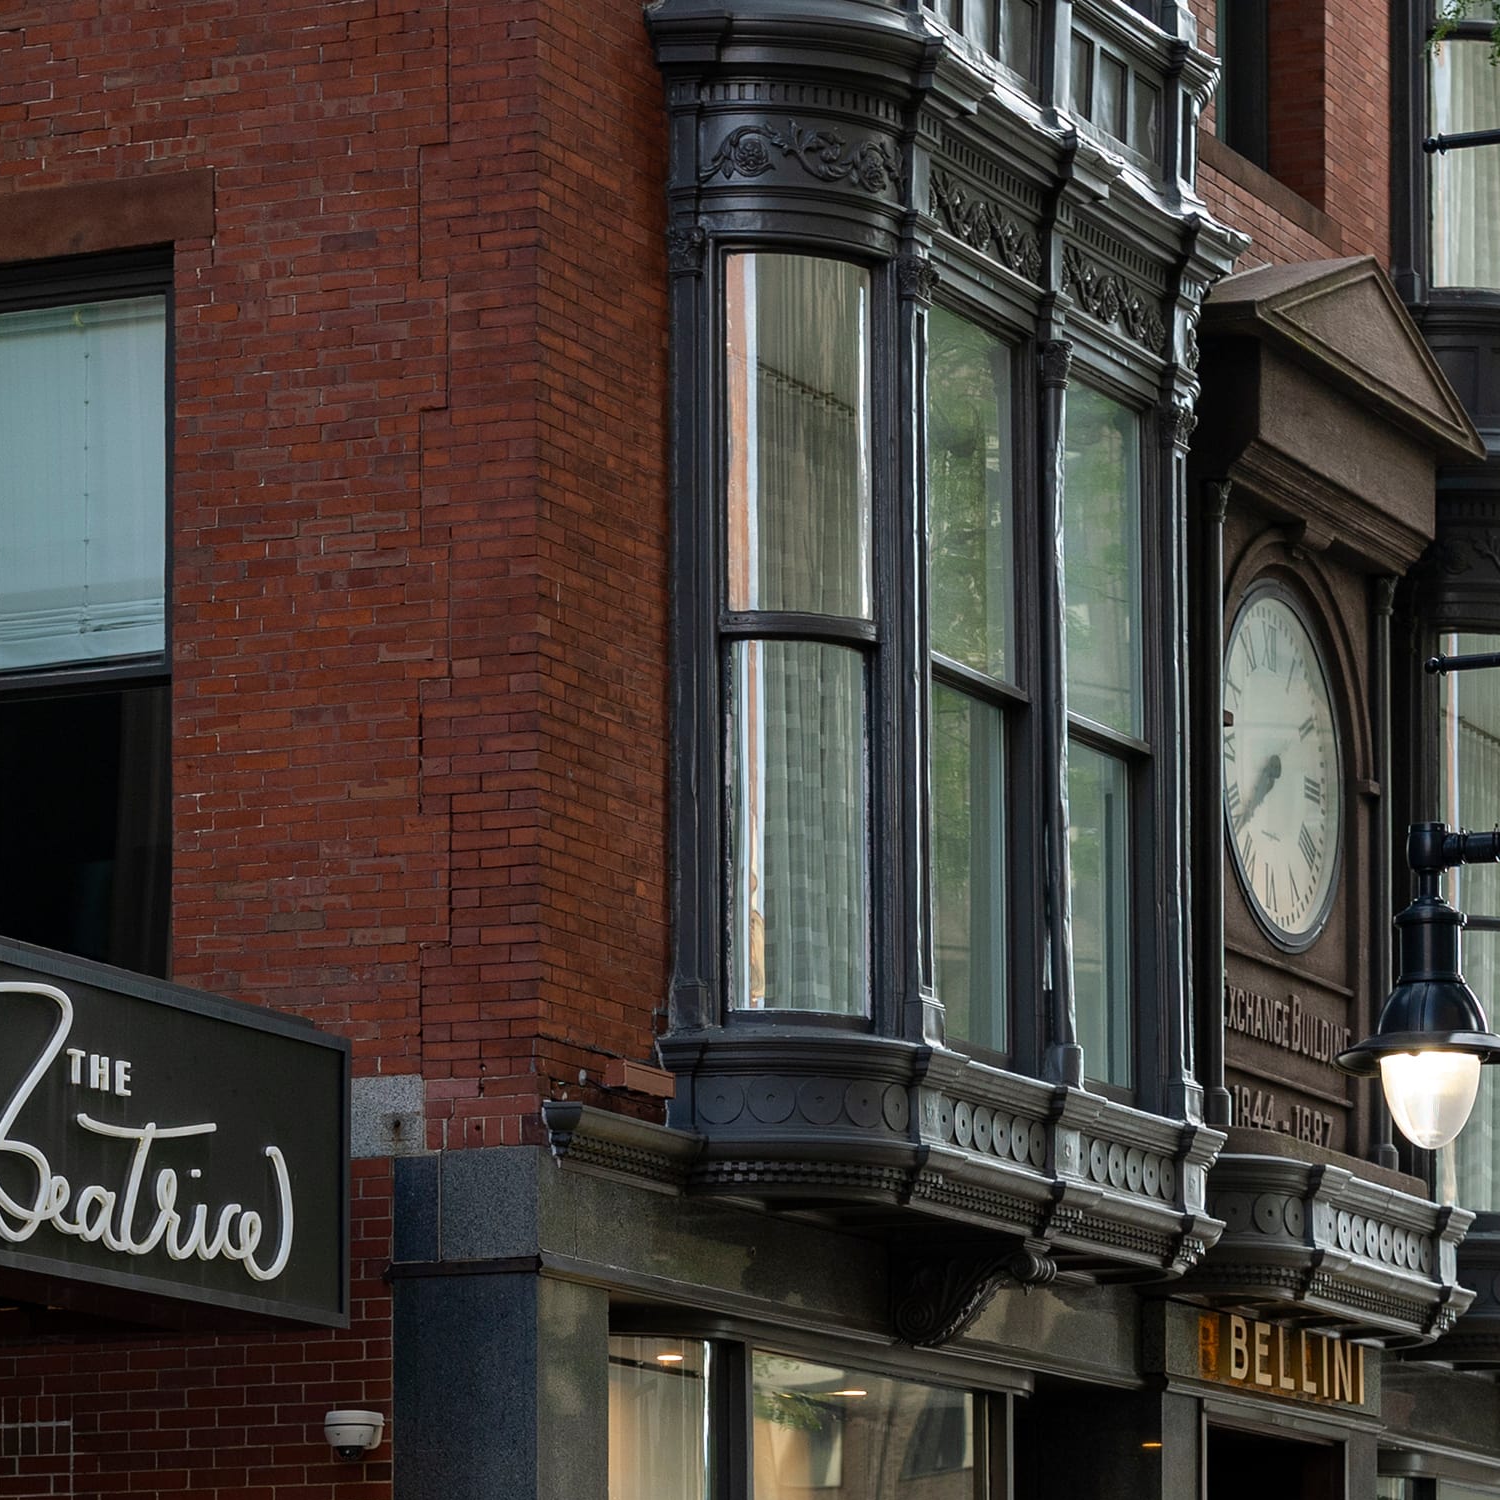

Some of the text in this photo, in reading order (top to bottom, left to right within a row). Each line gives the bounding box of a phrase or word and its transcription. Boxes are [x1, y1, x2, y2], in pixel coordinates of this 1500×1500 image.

[1224, 969, 1290, 1048] XCHANGE
[66, 1047, 132, 1096] THE
[1294, 1104, 1335, 1149] 1887
[1230, 1313, 1365, 1406] BELLINI
